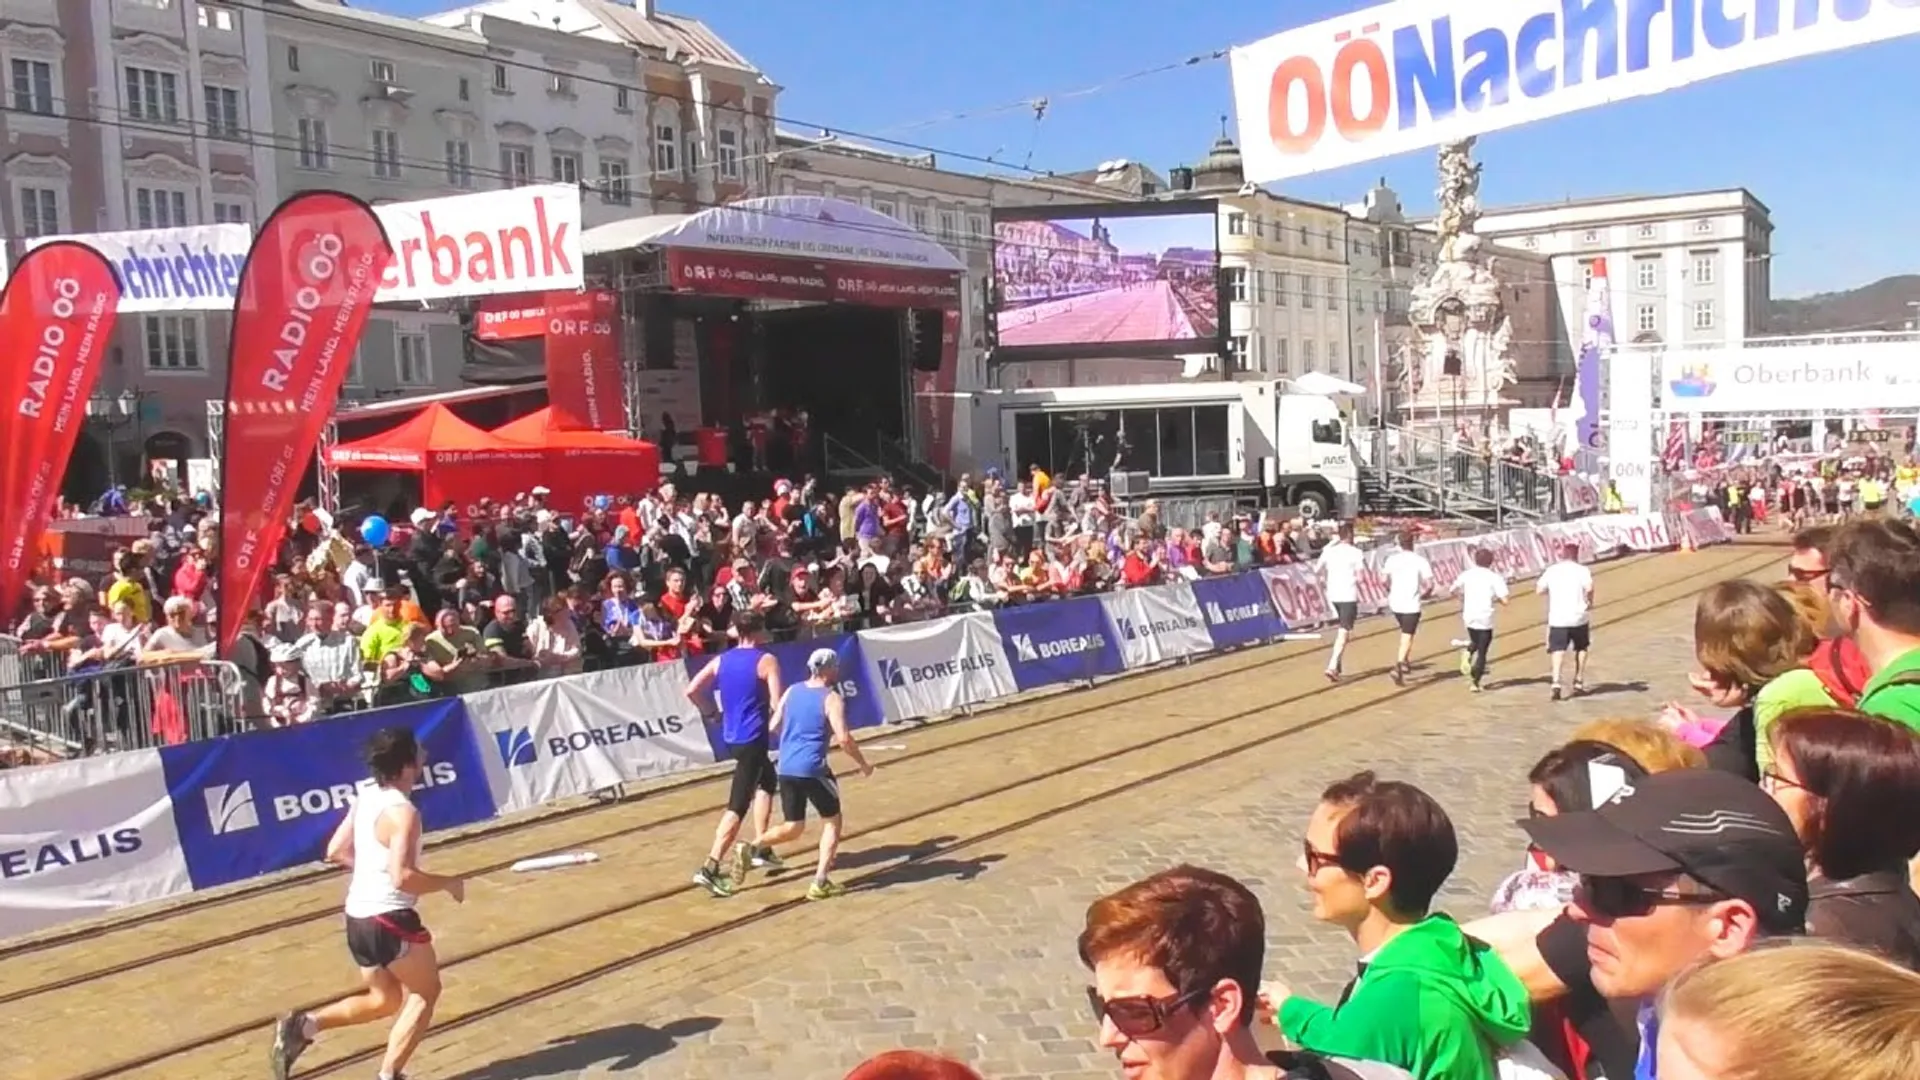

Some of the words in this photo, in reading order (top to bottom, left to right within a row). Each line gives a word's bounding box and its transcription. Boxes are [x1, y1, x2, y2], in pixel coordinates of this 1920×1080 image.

[1268, 0, 1918, 155] OÖNachric
[684, 264, 715, 279] ORF
[837, 277, 863, 292] ORF
[261, 286, 321, 392] RADIO
[310, 233, 343, 279] OÖ
[549, 318, 589, 336] ORF
[19, 325, 65, 418] RADIO
[53, 278, 80, 318] OÖ
[300, 378, 319, 412] MEIN
[315, 336, 340, 380] LAND.
[333, 300, 355, 334] MEIN
[1734, 361, 1871, 384] Oberbank
[236, 530, 258, 568] ORF
[1039, 633, 1106, 659] BOREALIS
[910, 651, 996, 685] BOREALIS
[549, 714, 684, 758] BOREALIS
[273, 761, 457, 821] BORIS
